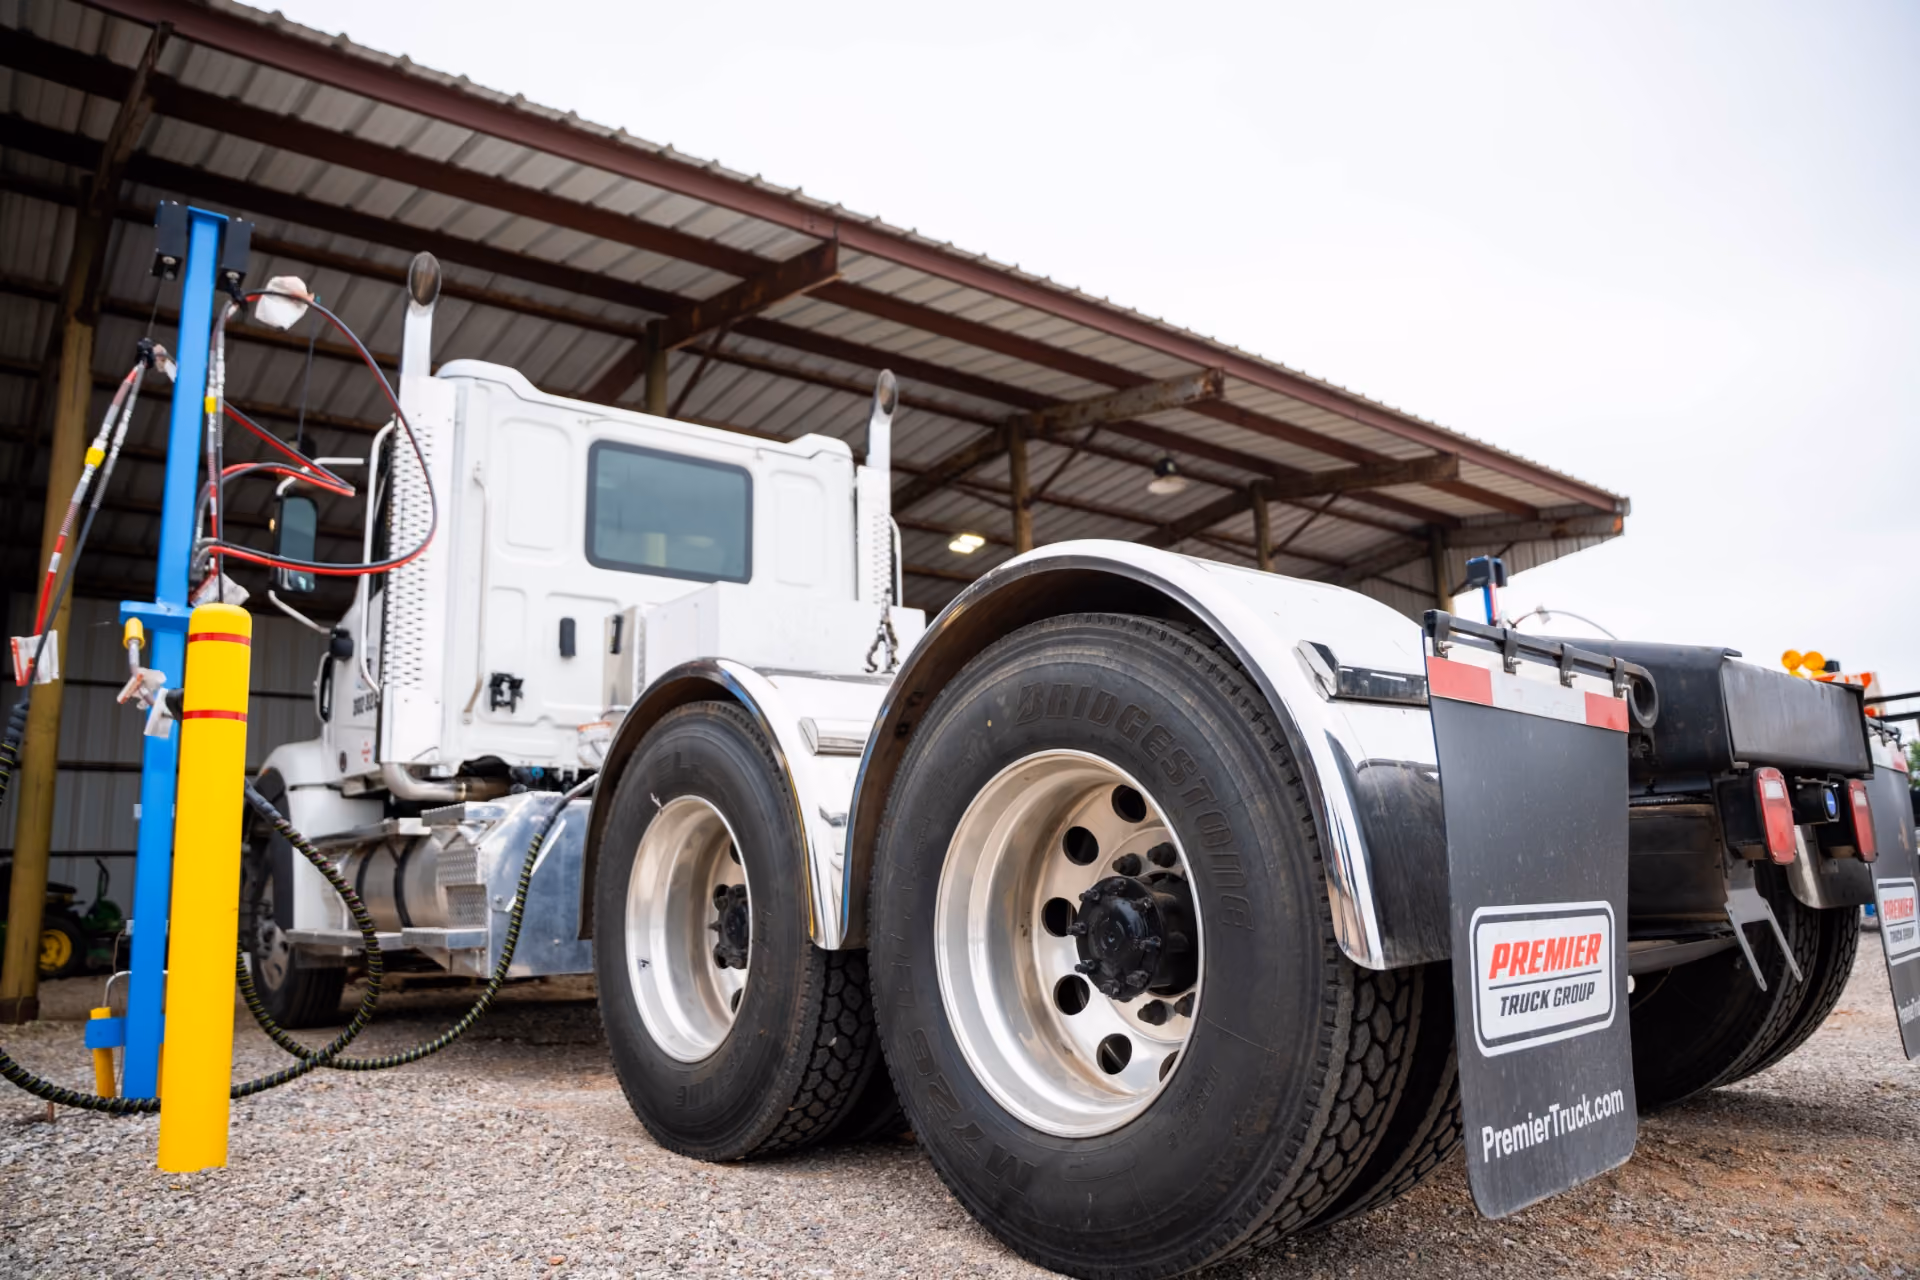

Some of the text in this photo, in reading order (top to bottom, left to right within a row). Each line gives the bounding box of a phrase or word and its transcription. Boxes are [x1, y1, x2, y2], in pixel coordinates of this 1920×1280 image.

[1016, 682, 1255, 931] BRIDGESTONE
[1488, 933, 1602, 980] PREMIER
[1500, 981, 1595, 1017] TRUCK GROUP
[1481, 1089, 1625, 1163] PremierTruck.com
